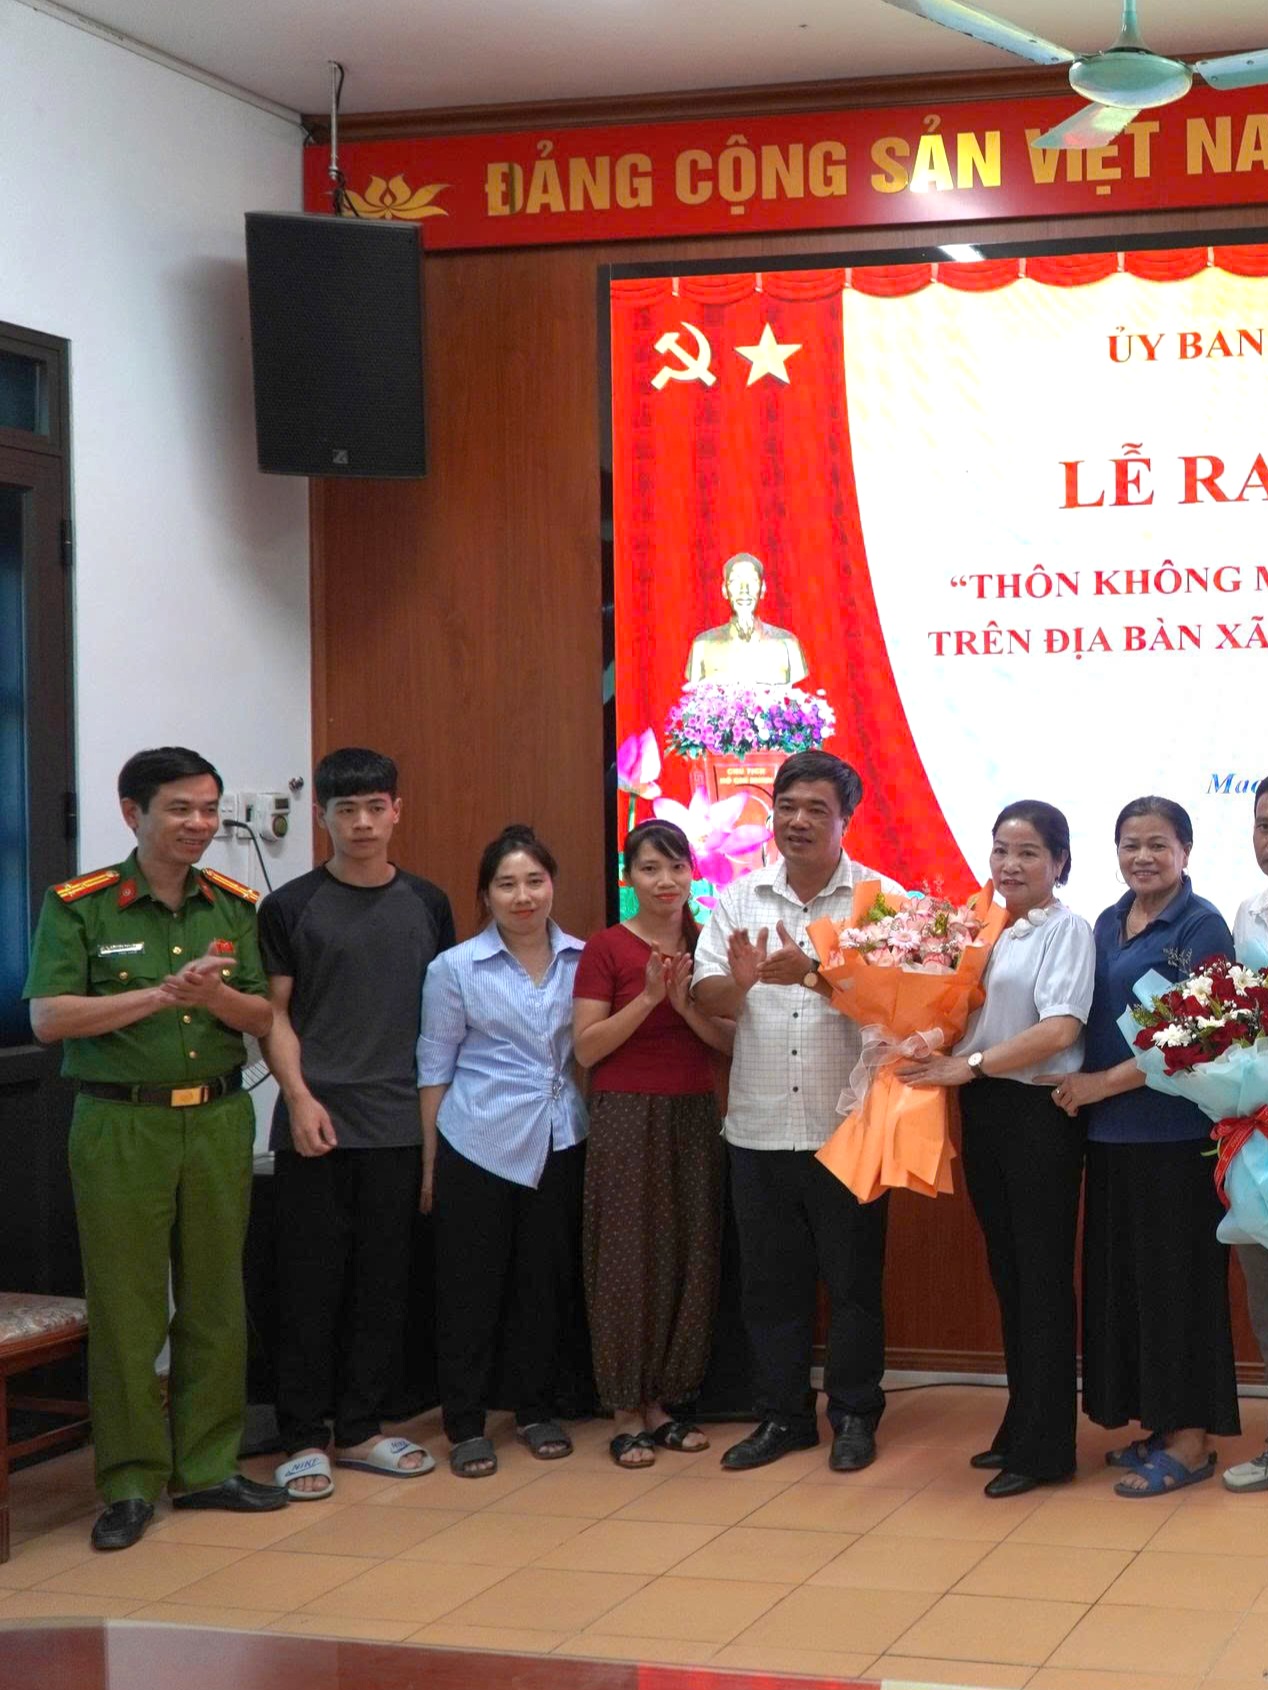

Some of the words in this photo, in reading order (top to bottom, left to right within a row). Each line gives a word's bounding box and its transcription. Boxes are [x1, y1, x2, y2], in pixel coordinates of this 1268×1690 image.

[485, 141, 653, 216] ĐẢNG
[675, 136, 848, 215] CỘNG
[870, 114, 1001, 193] SẢN
[1108, 325, 1163, 363] ỦY
[1179, 328, 1263, 359] BAN
[1059, 442, 1154, 509] LỄ
[950, 563, 1079, 599] “THÔN
[1094, 559, 1241, 596] KHÔNG
[928, 620, 1031, 657] TRÊN
[1043, 627, 1112, 659] ĐỊA
[1124, 617, 1201, 652] BÀN
